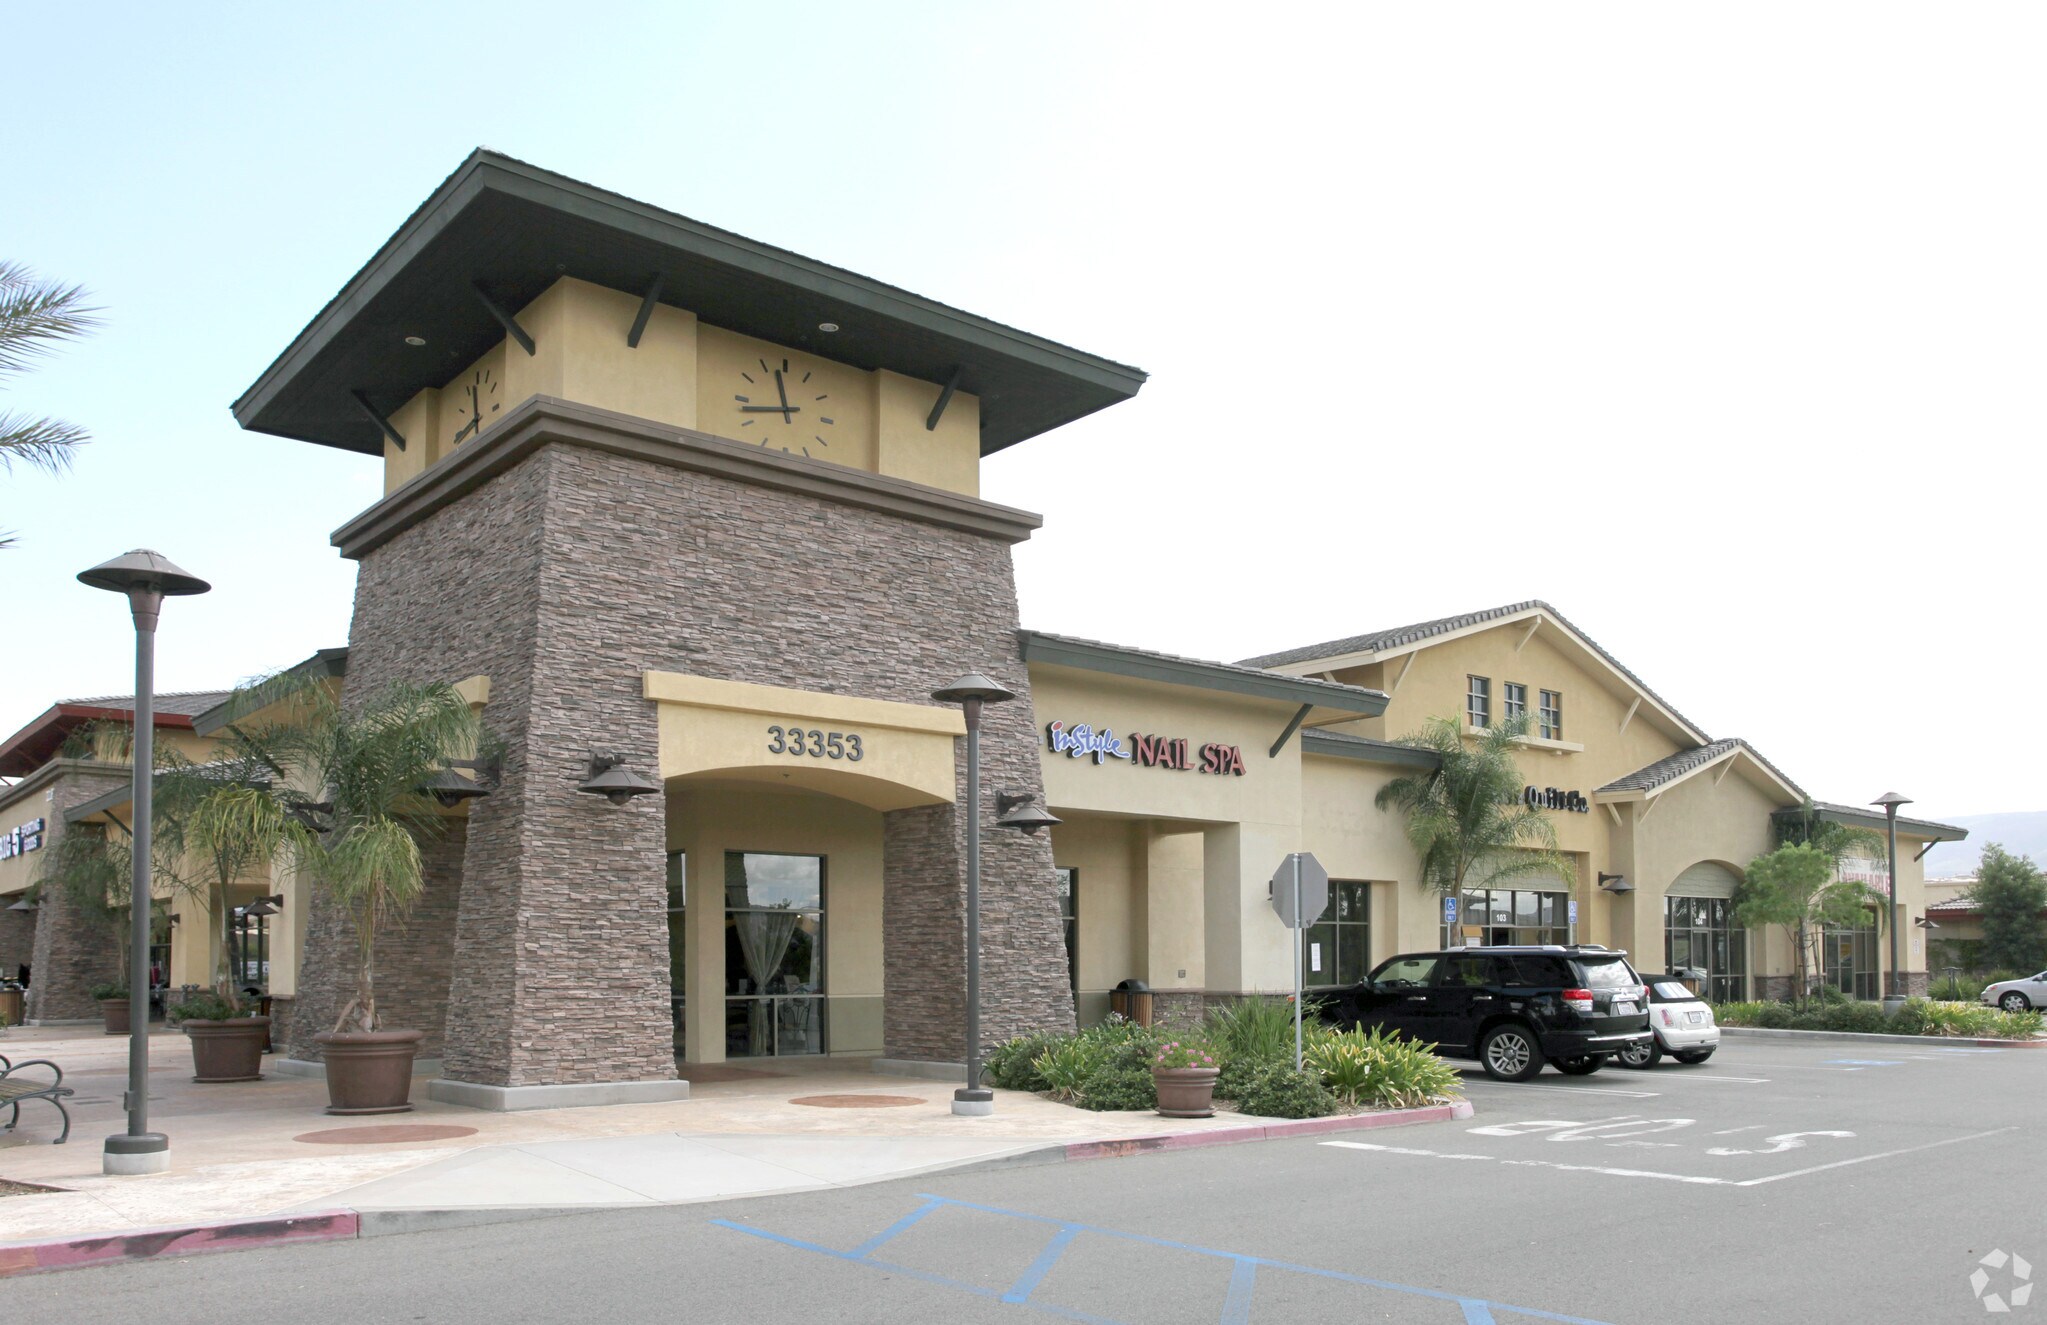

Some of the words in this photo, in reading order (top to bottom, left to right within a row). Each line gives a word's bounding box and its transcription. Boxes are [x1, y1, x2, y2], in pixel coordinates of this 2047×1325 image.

[767, 725, 864, 762] 33353
[1048, 720, 1131, 765] inStyle
[1130, 732, 1196, 769] NAIL
[1199, 742, 1247, 776] SPA
[12, 826, 21, 856] 5
[1496, 914, 1507, 922] 103
